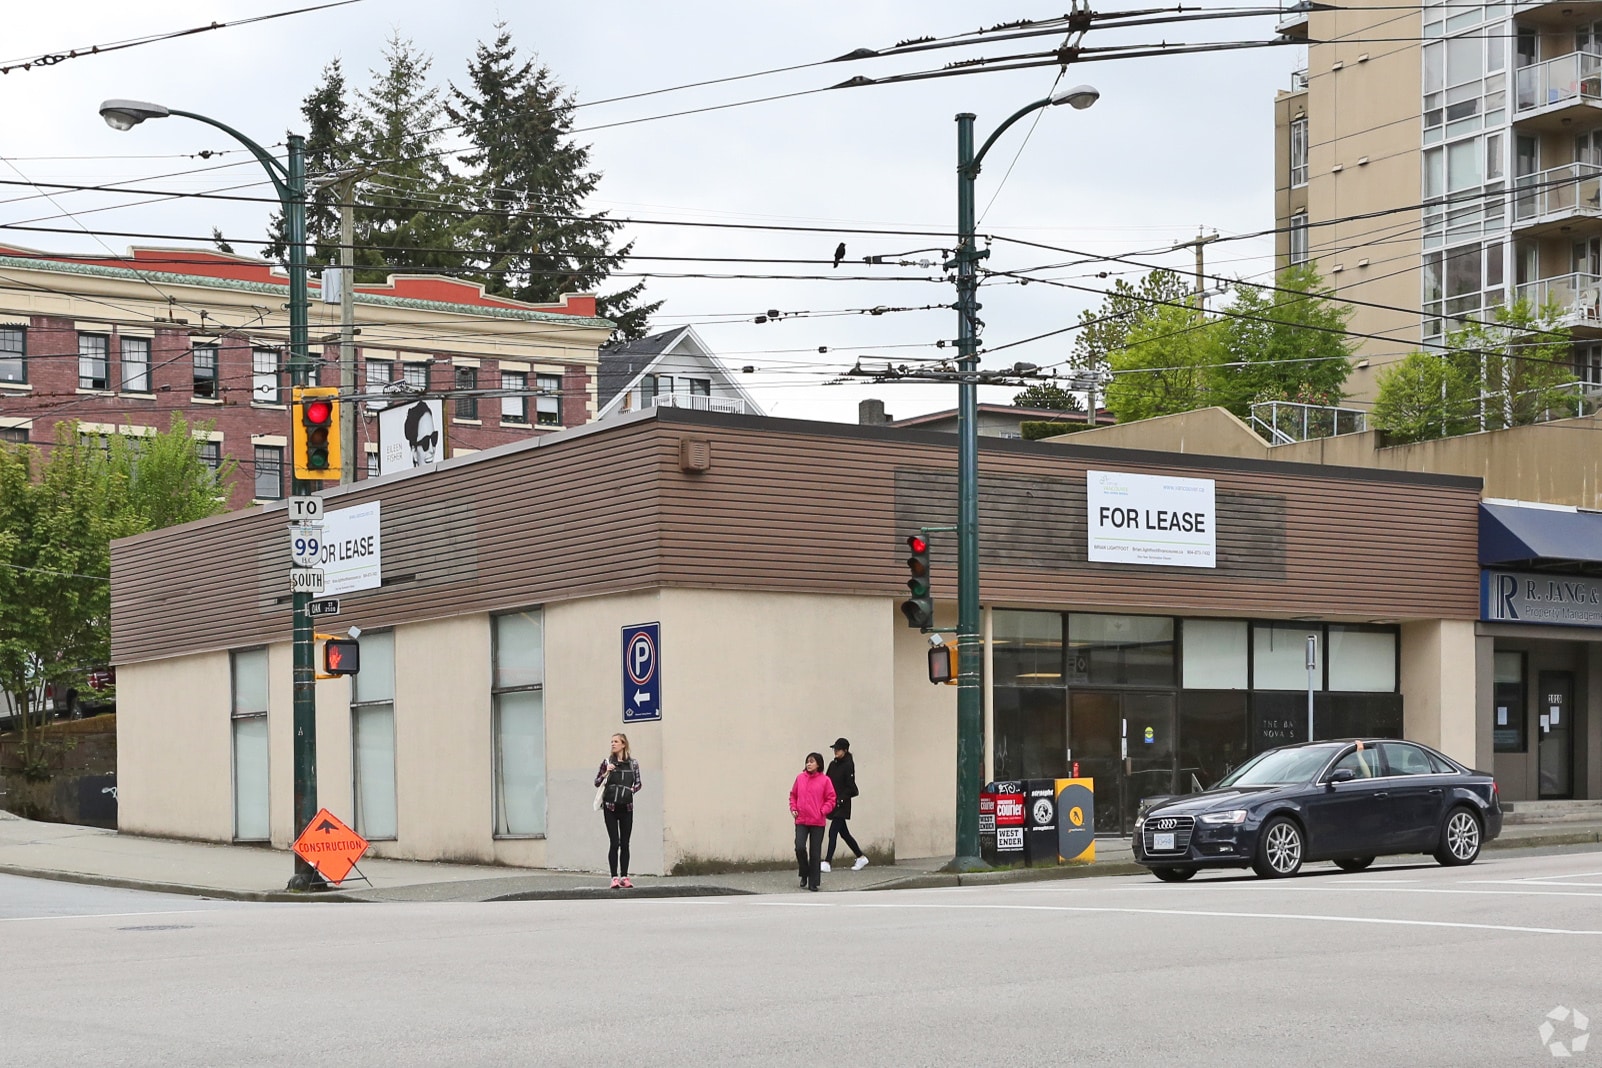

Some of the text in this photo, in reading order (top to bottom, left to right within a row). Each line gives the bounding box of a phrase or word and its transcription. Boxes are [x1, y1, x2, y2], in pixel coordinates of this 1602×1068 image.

[386, 443, 402, 454] EILEEN
[386, 453, 402, 463] FISHER
[294, 501, 317, 514] TO
[1100, 507, 1205, 533] FOR LEASE
[295, 538, 319, 556] 99
[321, 536, 374, 564] OR LEASE
[293, 573, 322, 587] SOUTH
[1525, 580, 1599, 605] R. JANG &
[312, 603, 321, 613] OAK
[1525, 606, 1559, 620] Property
[635, 641, 649, 676] P
[1263, 730, 1284, 738] NOVA
[298, 840, 362, 853] CONSTRUCTION
[999, 838, 1022, 846] ENDER
